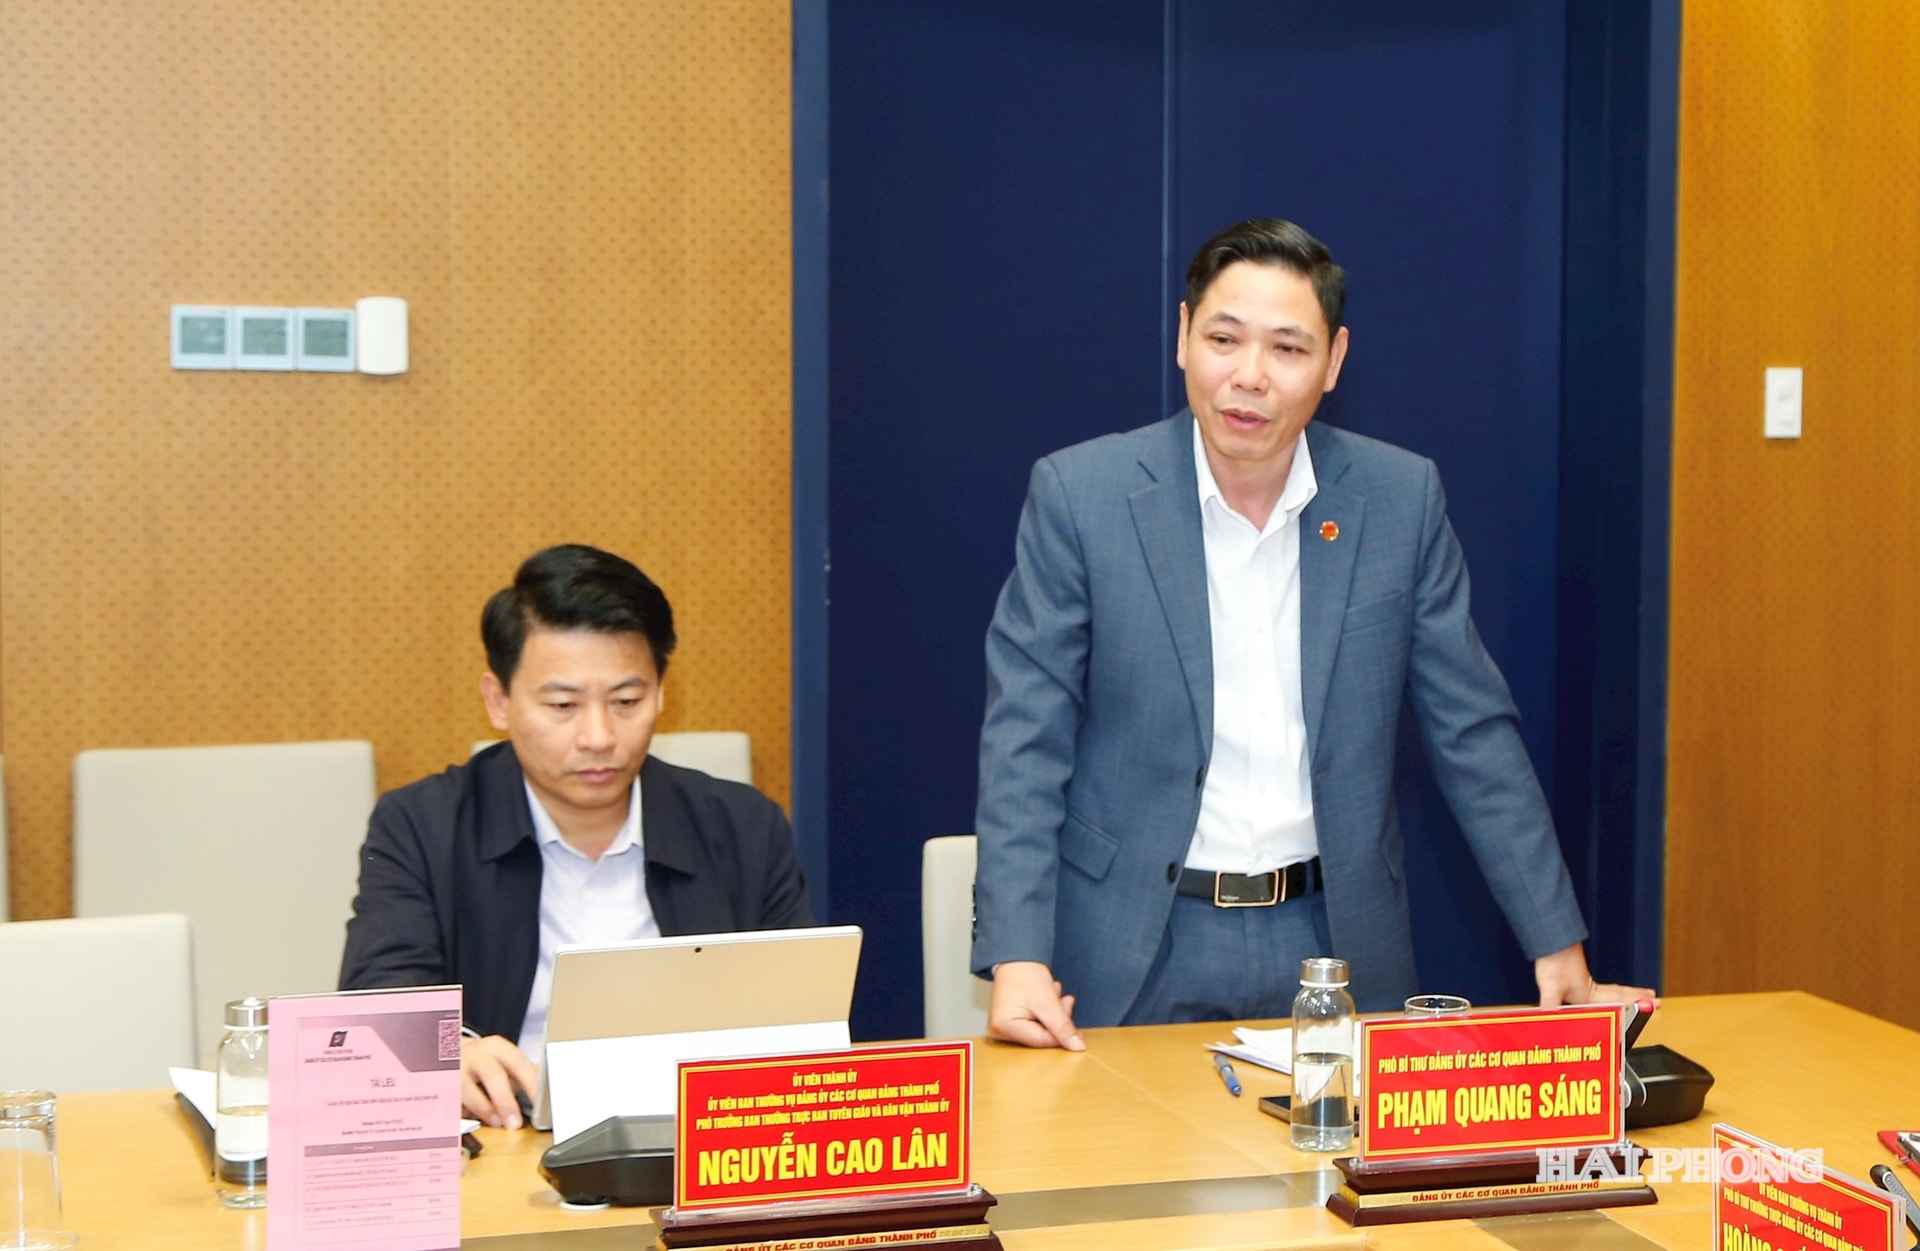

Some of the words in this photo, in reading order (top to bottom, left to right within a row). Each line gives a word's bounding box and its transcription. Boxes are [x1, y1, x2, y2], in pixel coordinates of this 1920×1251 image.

[1378, 1056, 1397, 1074] PHÓ
[1398, 1054, 1409, 1072] BÍ
[1410, 1054, 1428, 1072] THƯ
[1429, 1051, 1453, 1071] ĐẢNG
[1455, 1050, 1467, 1069] ỦY
[1468, 1050, 1486, 1068] CÁC
[1488, 1050, 1501, 1067] CƠ
[1502, 1049, 1526, 1067] QUAN
[1527, 1045, 1551, 1065] ĐẢNG
[1553, 1045, 1582, 1062] THÀNH
[1583, 1041, 1602, 1060] PHỐ
[1378, 1089, 1447, 1135] PHẠM
[1454, 1083, 1532, 1128] QUANG
[1538, 1073, 1601, 1118] SÁNG
[698, 1131, 817, 1186] NGUYỄN
[826, 1137, 884, 1176] CAO
[892, 1127, 947, 1171] LÂN
[1412, 1193, 1438, 1203] ĐẢNG
[1441, 1192, 1453, 1201] ỦY
[1456, 1190, 1474, 1199] CÁC
[1477, 1189, 1490, 1197] CƠ
[1492, 1187, 1517, 1197] QUAN
[1520, 1185, 1545, 1194] ĐẢNG
[1548, 1182, 1578, 1192] THÀNH
[1580, 1181, 1600, 1190] PHỐ
[775, 1242, 797, 1251] CÁC
[799, 1240, 814, 1249] CƠ
[817, 1239, 845, 1249] QUAN
[848, 1235, 876, 1246] ĐẢNG
[880, 1232, 913, 1243] THÀNH
[916, 1229, 937, 1240] PHỐ
